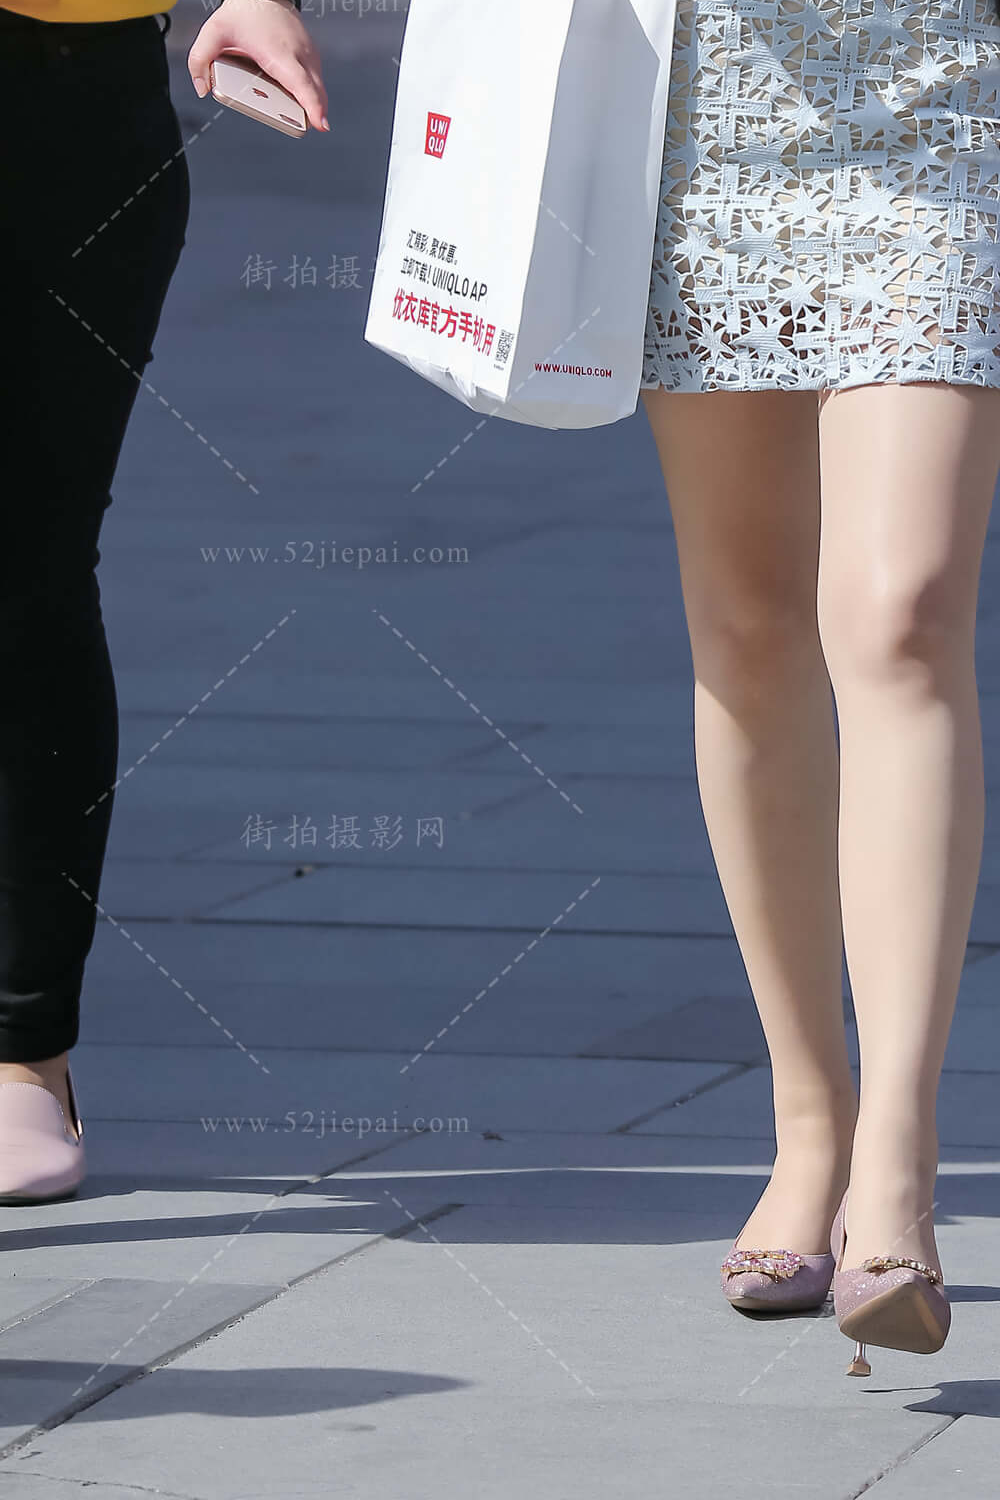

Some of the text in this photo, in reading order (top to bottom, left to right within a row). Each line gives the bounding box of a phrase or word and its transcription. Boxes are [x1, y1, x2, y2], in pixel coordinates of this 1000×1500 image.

[430, 117, 449, 136] UNI
[428, 135, 445, 155] QLO
[432, 266, 470, 297] UNIQLO
[534, 363, 612, 378] WWW.UNIQLO.COM
